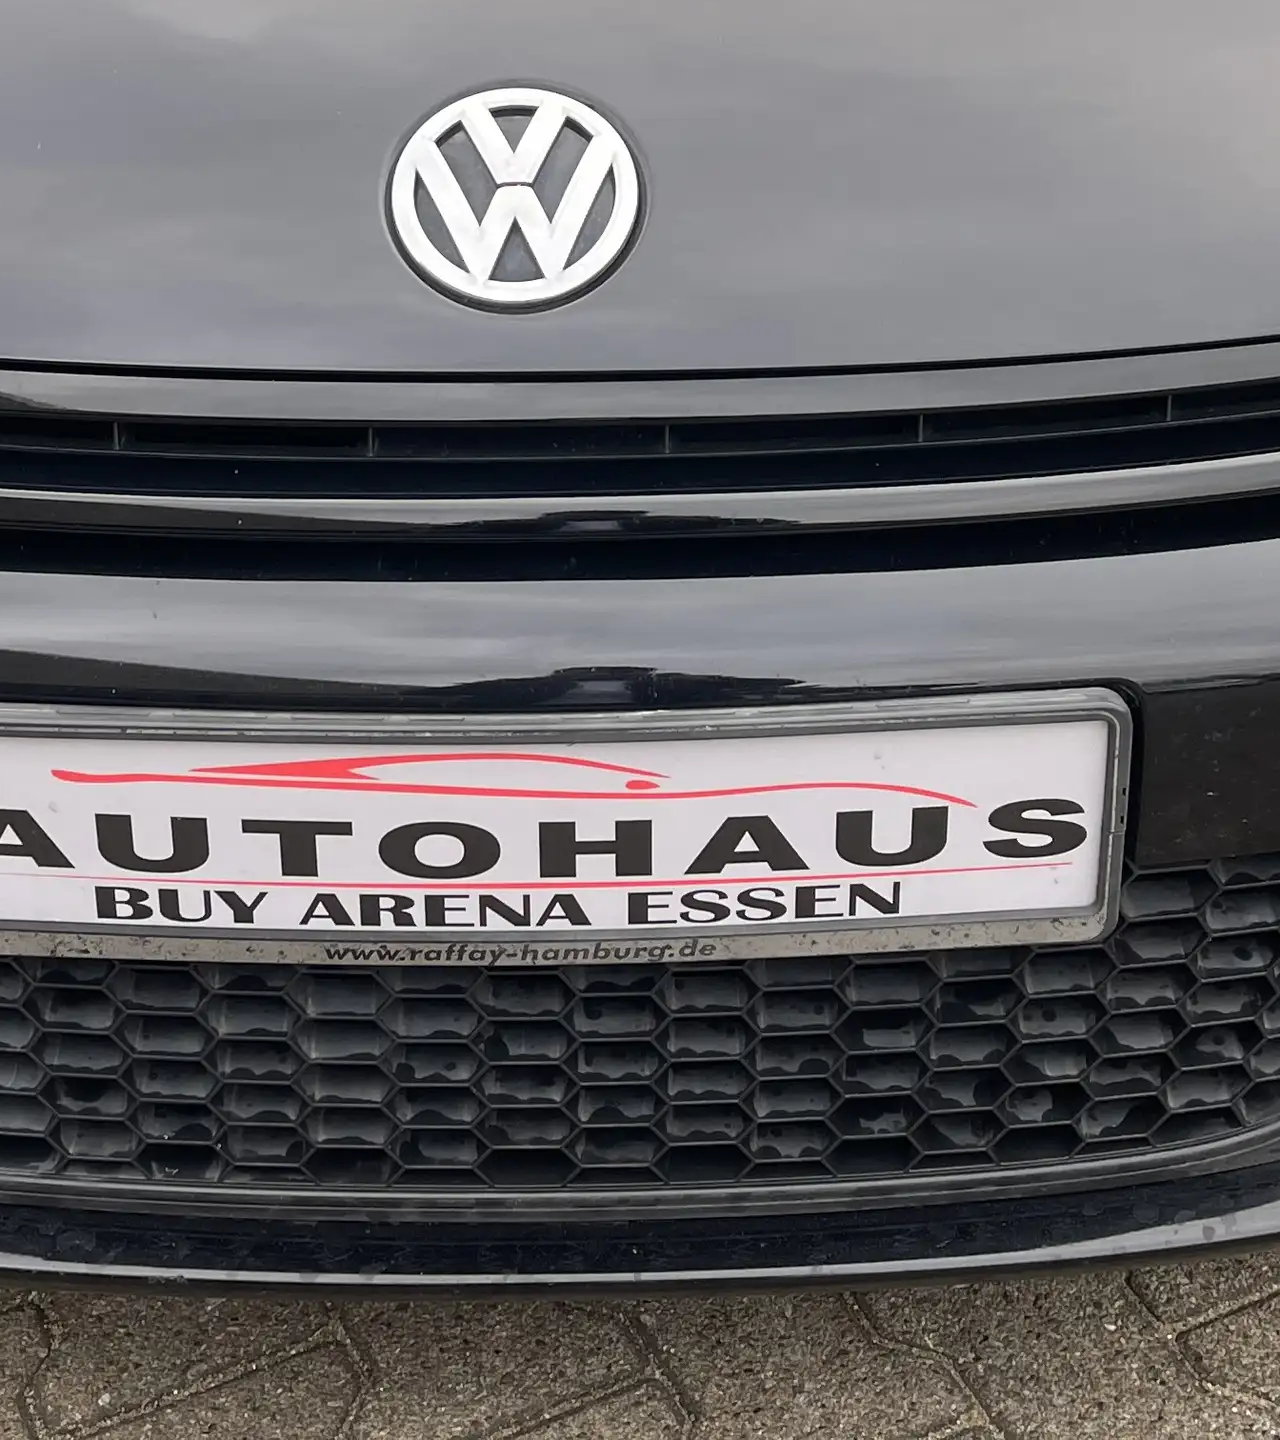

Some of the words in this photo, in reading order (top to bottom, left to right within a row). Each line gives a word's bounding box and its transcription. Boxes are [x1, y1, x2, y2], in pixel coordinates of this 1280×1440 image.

[393, 88, 638, 302] VW
[93, 885, 269, 924] BUY
[299, 893, 592, 927] ARENA
[627, 881, 901, 924] ESSEN
[324, 938, 718, 968] www.raffay-hamburg.de
